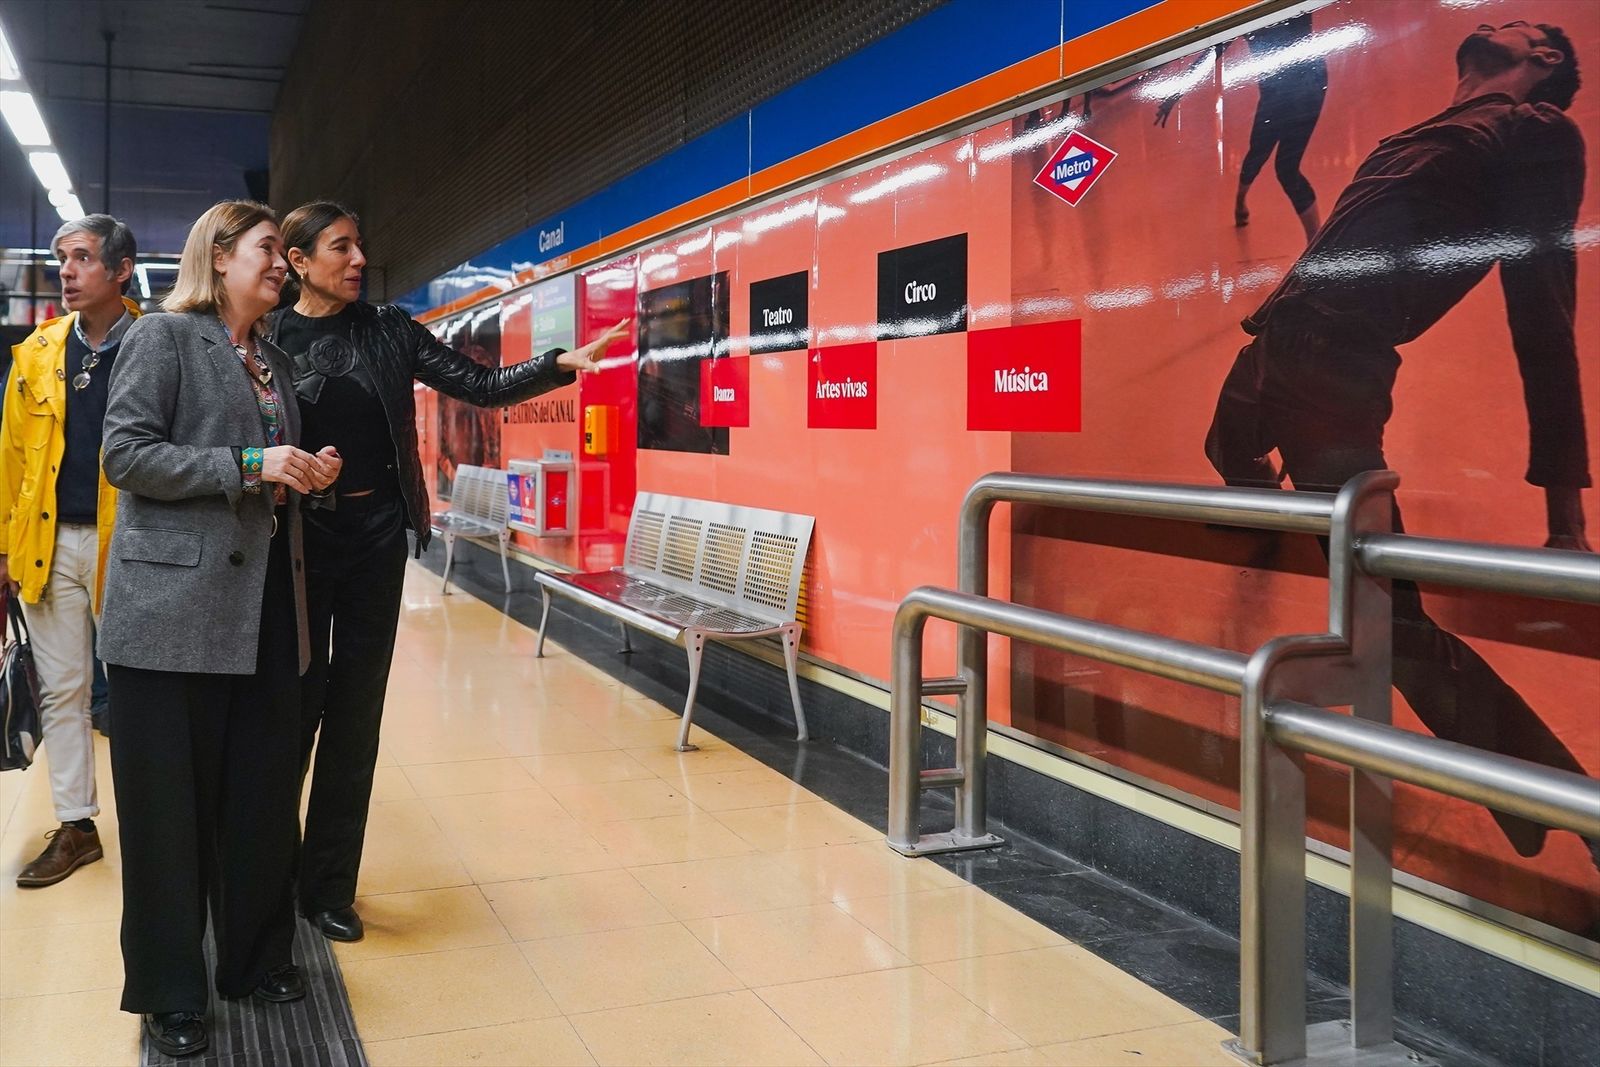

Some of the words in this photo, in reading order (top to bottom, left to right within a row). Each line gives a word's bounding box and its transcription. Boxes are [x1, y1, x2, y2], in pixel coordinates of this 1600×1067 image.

[1056, 160, 1091, 180] Metro
[539, 220, 564, 253] Canal
[904, 280, 937, 305] Circo
[762, 306, 793, 327] Teatro
[815, 379, 841, 399] Artes
[841, 377, 868, 398] vivas
[994, 366, 1049, 393] Música
[713, 385, 735, 402] Danza
[550, 399, 575, 423] CANAL
